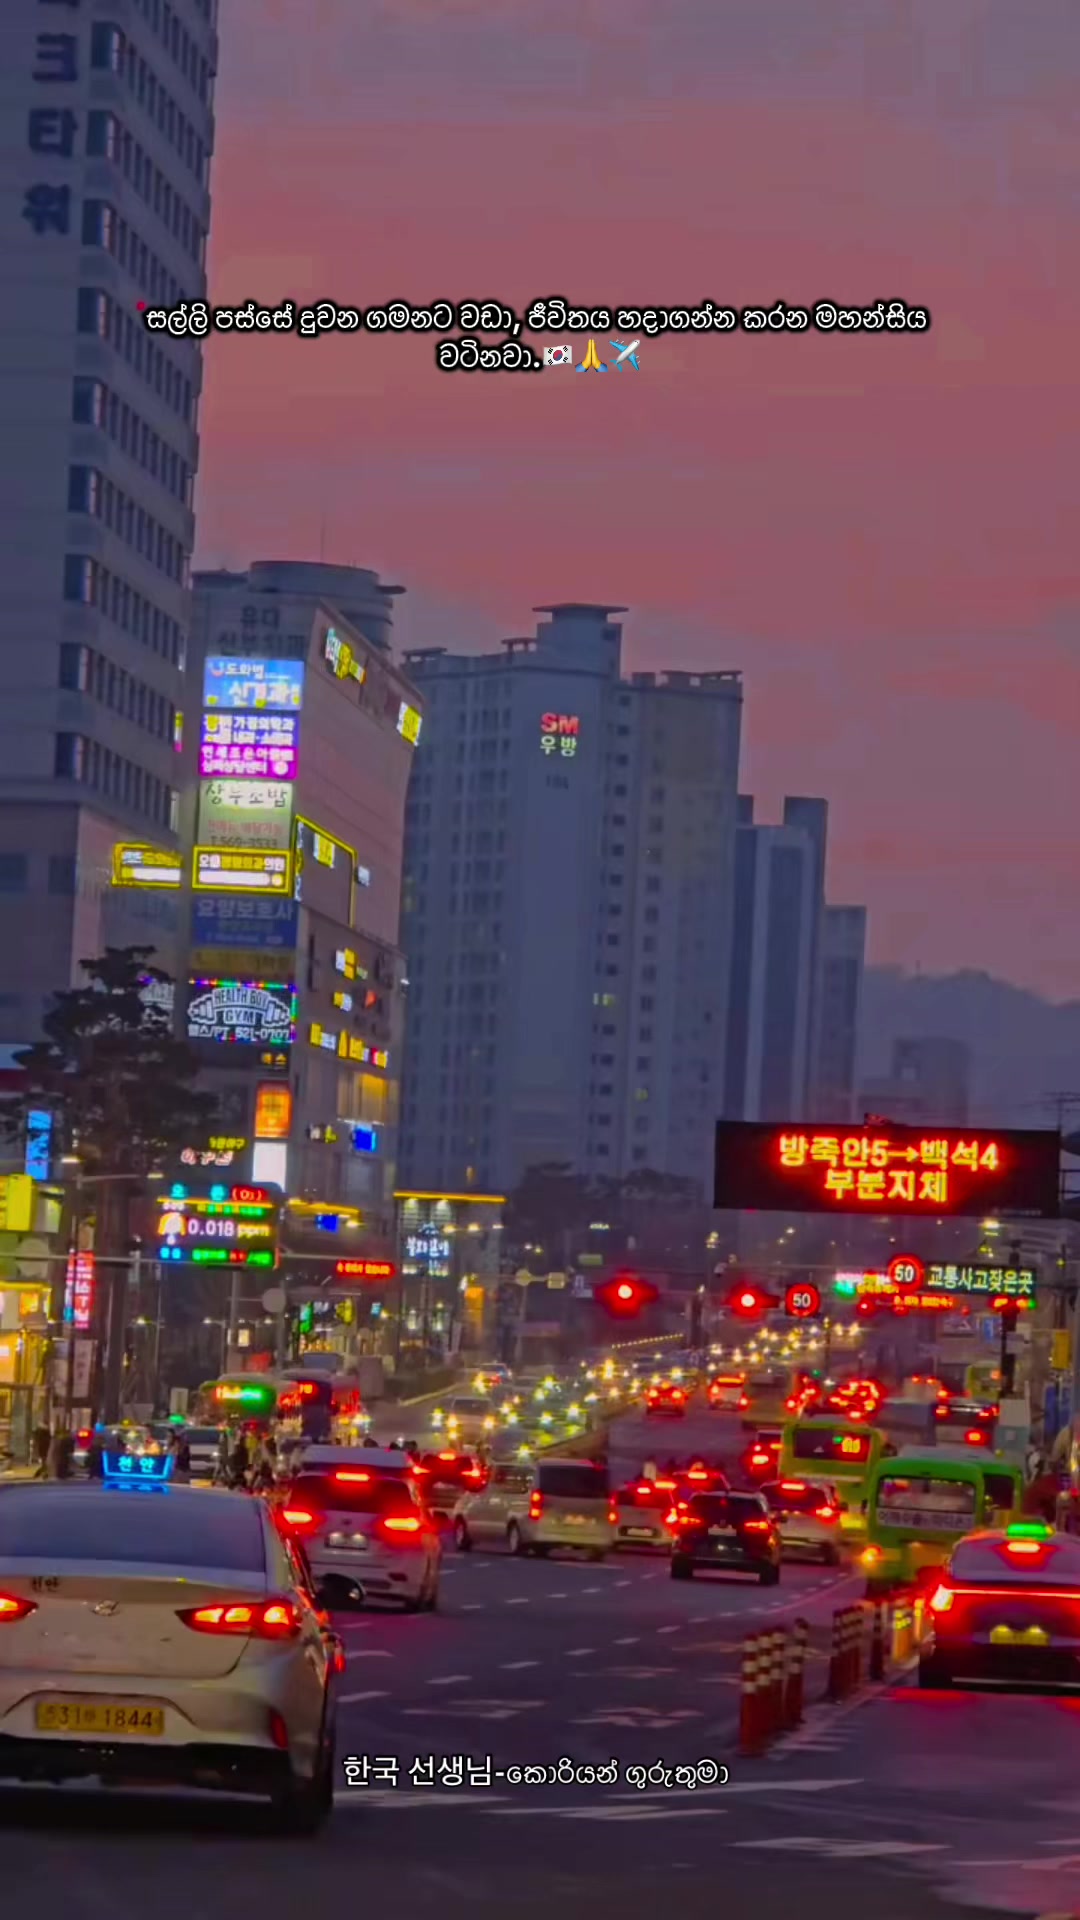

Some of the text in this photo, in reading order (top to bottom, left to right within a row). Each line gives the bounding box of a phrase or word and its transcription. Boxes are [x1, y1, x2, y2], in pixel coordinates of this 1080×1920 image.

[20, 0, 79, 236] 크타워
[541, 712, 579, 735] SM
[540, 735, 577, 757] 우방
[213, 988, 247, 1006] HEALTH
[225, 1008, 255, 1024] GYM
[779, 1134, 999, 1172] 방죽안5 백석4
[825, 1168, 948, 1203] 부분지체
[894, 1263, 915, 1282] 50
[792, 1291, 811, 1307] 50
[104, 1708, 154, 1729] 1844
